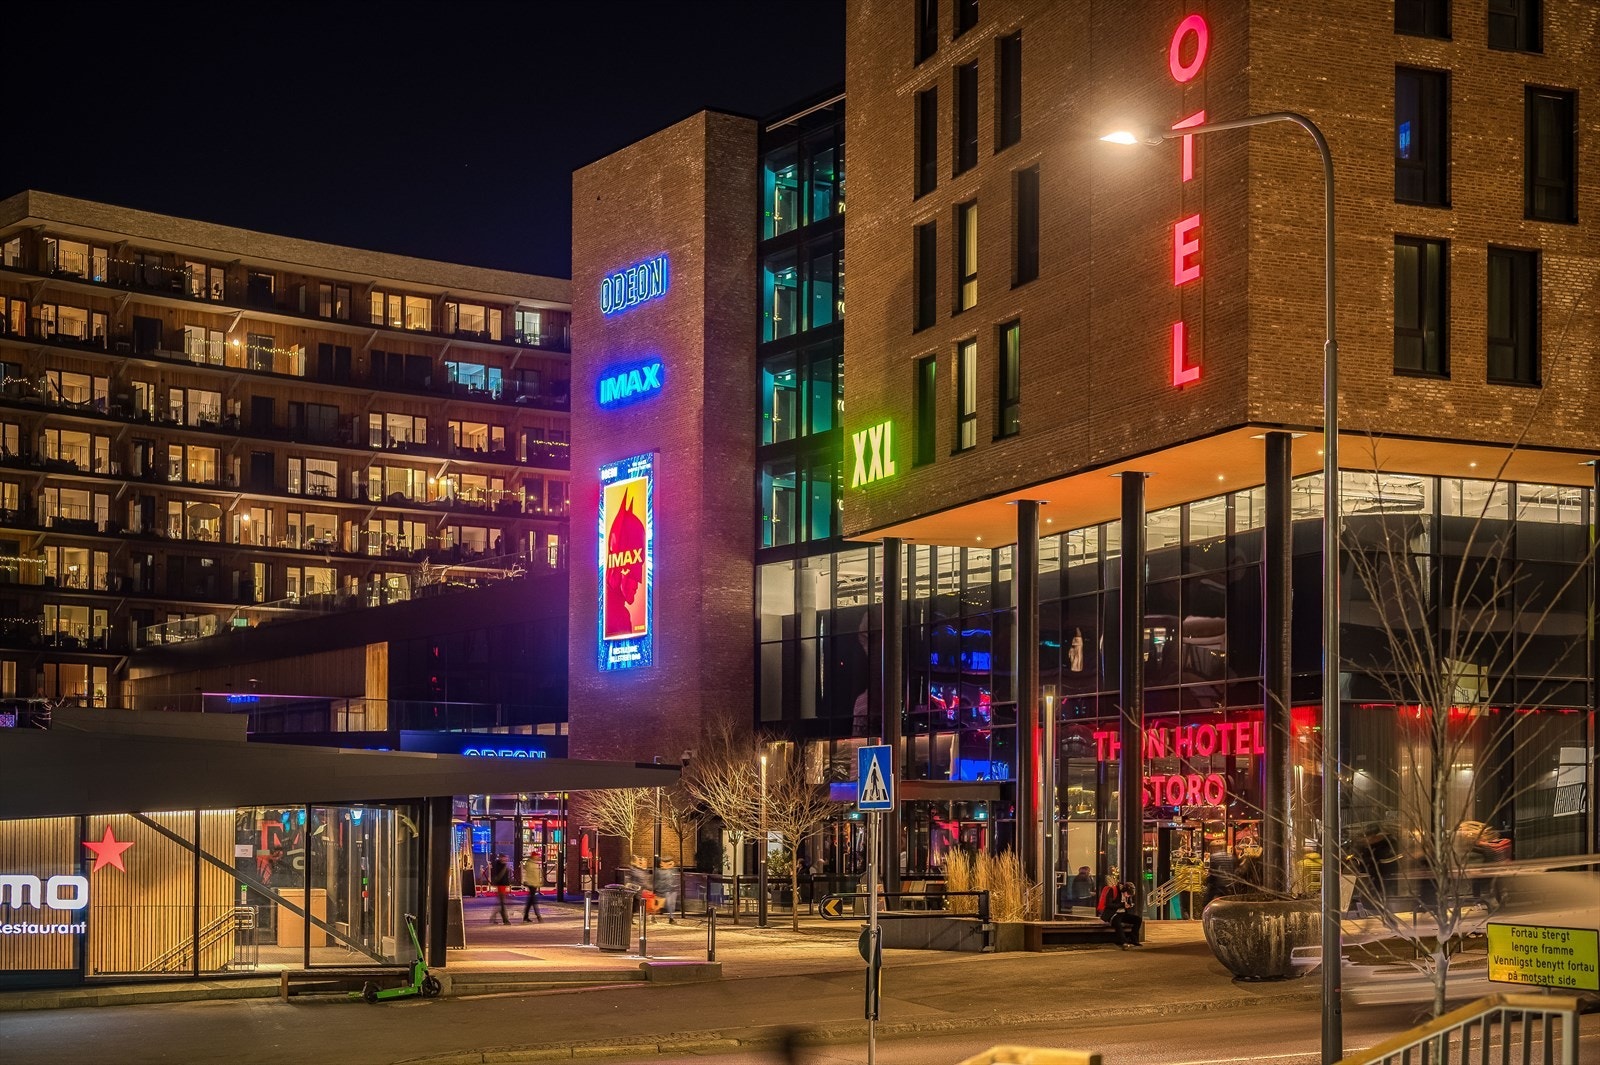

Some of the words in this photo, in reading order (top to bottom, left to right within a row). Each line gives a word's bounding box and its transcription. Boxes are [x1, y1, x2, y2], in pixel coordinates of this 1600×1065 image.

[600, 257, 667, 314] ODEON
[600, 363, 661, 405] IMAX
[851, 419, 896, 489] XXL
[608, 547, 643, 569] IMAX
[1093, 727, 1168, 762] THN
[1175, 721, 1265, 758] HOTEL
[0, 921, 87, 935] estaurant
[1511, 927, 1538, 939] Fortau
[1511, 941, 1538, 954] lengre
[1542, 944, 1574, 956] framme
[1493, 955, 1533, 969] Vennligst
[1536, 958, 1564, 972] benytt
[1568, 960, 1595, 973] fortau
[1508, 971, 1518, 981] på
[1521, 973, 1554, 984] motsatt
[1558, 975, 1576, 986] side
